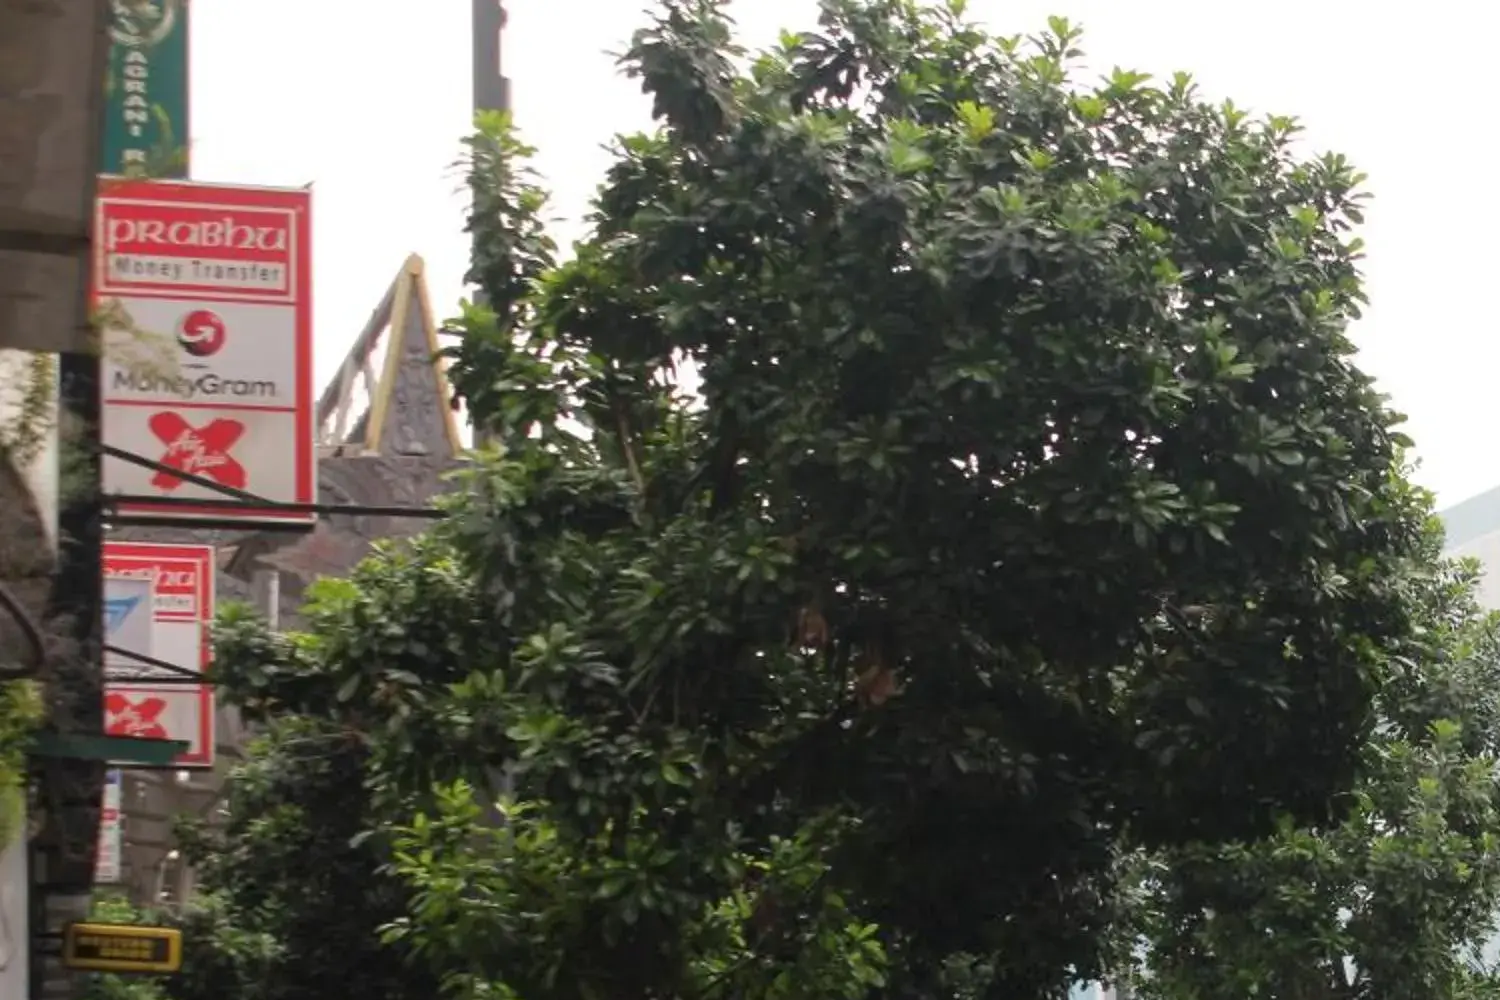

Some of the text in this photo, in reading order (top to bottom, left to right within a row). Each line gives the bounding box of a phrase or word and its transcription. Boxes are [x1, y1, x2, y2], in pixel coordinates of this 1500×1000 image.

[123, 51, 149, 137] AGRANI
[114, 256, 280, 282] Money Transfer
[114, 370, 275, 398] MoneyGram
